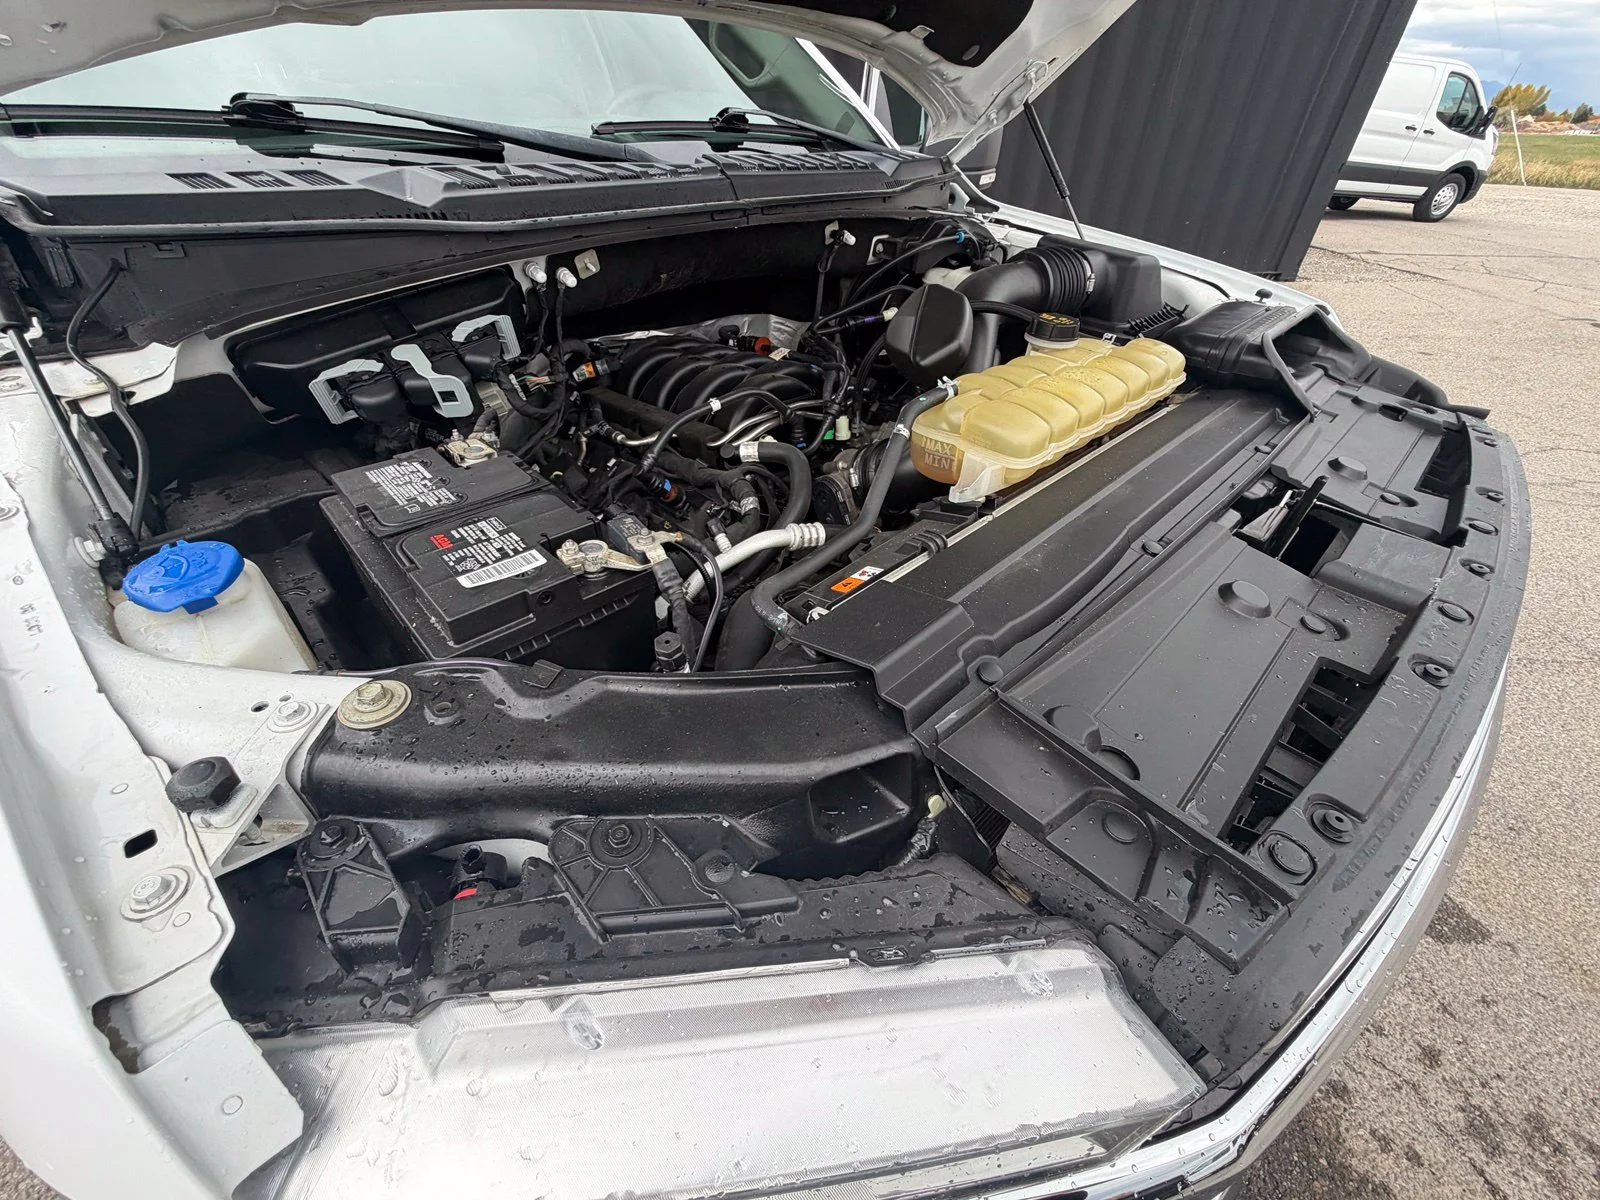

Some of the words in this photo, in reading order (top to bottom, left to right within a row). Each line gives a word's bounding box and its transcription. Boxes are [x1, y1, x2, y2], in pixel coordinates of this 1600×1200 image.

[925, 437, 952, 455] MAX
[924, 452, 950, 469] MIN
[433, 534, 454, 549] AGM
